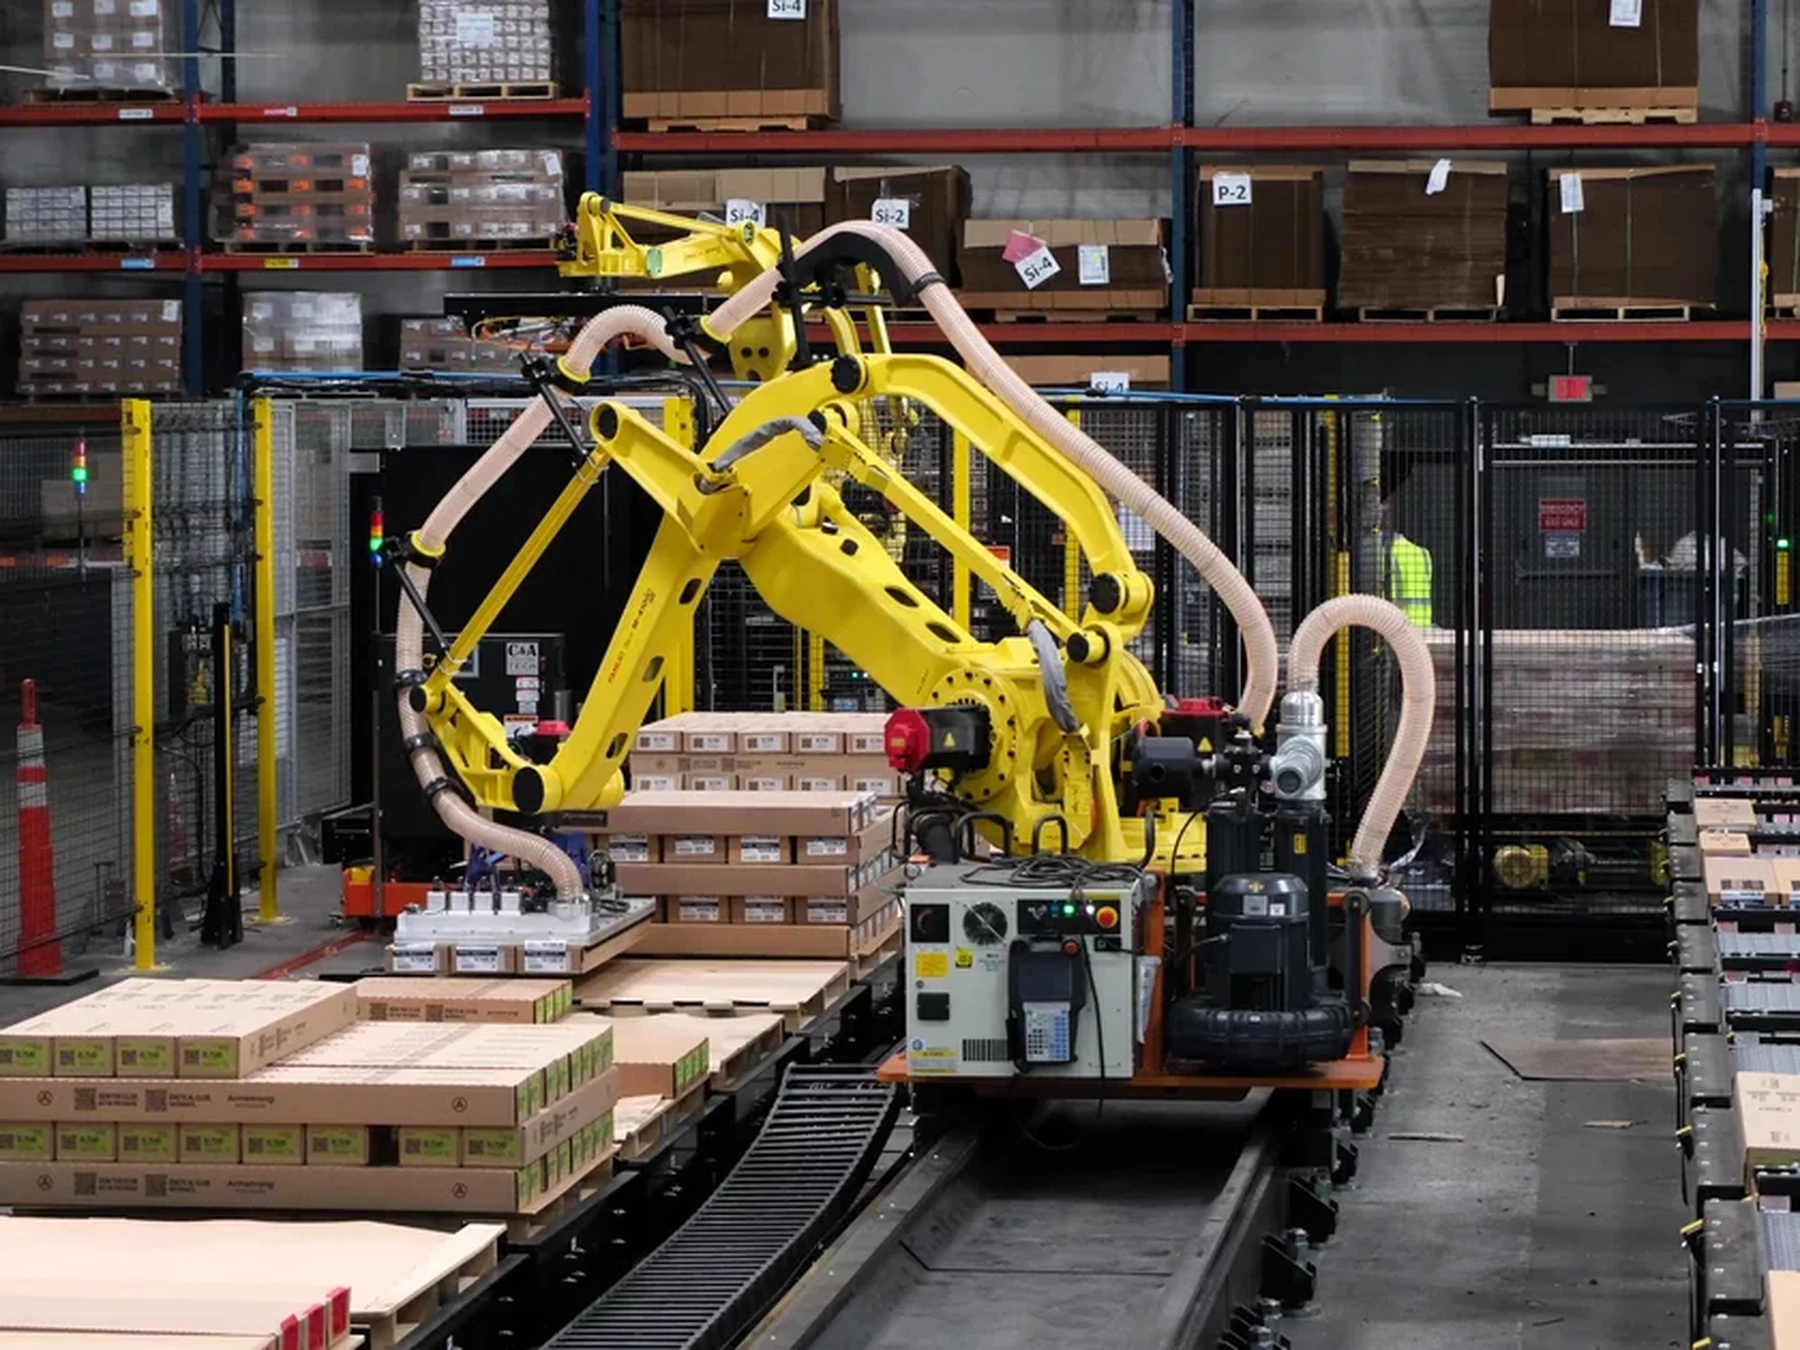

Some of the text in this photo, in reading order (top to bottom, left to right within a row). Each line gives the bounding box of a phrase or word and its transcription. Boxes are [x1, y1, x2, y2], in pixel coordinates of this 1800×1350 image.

[1218, 185, 1247, 200] P-2
[730, 208, 760, 222] Si-4
[875, 208, 905, 224] Si-2
[1023, 256, 1053, 282] Si-4
